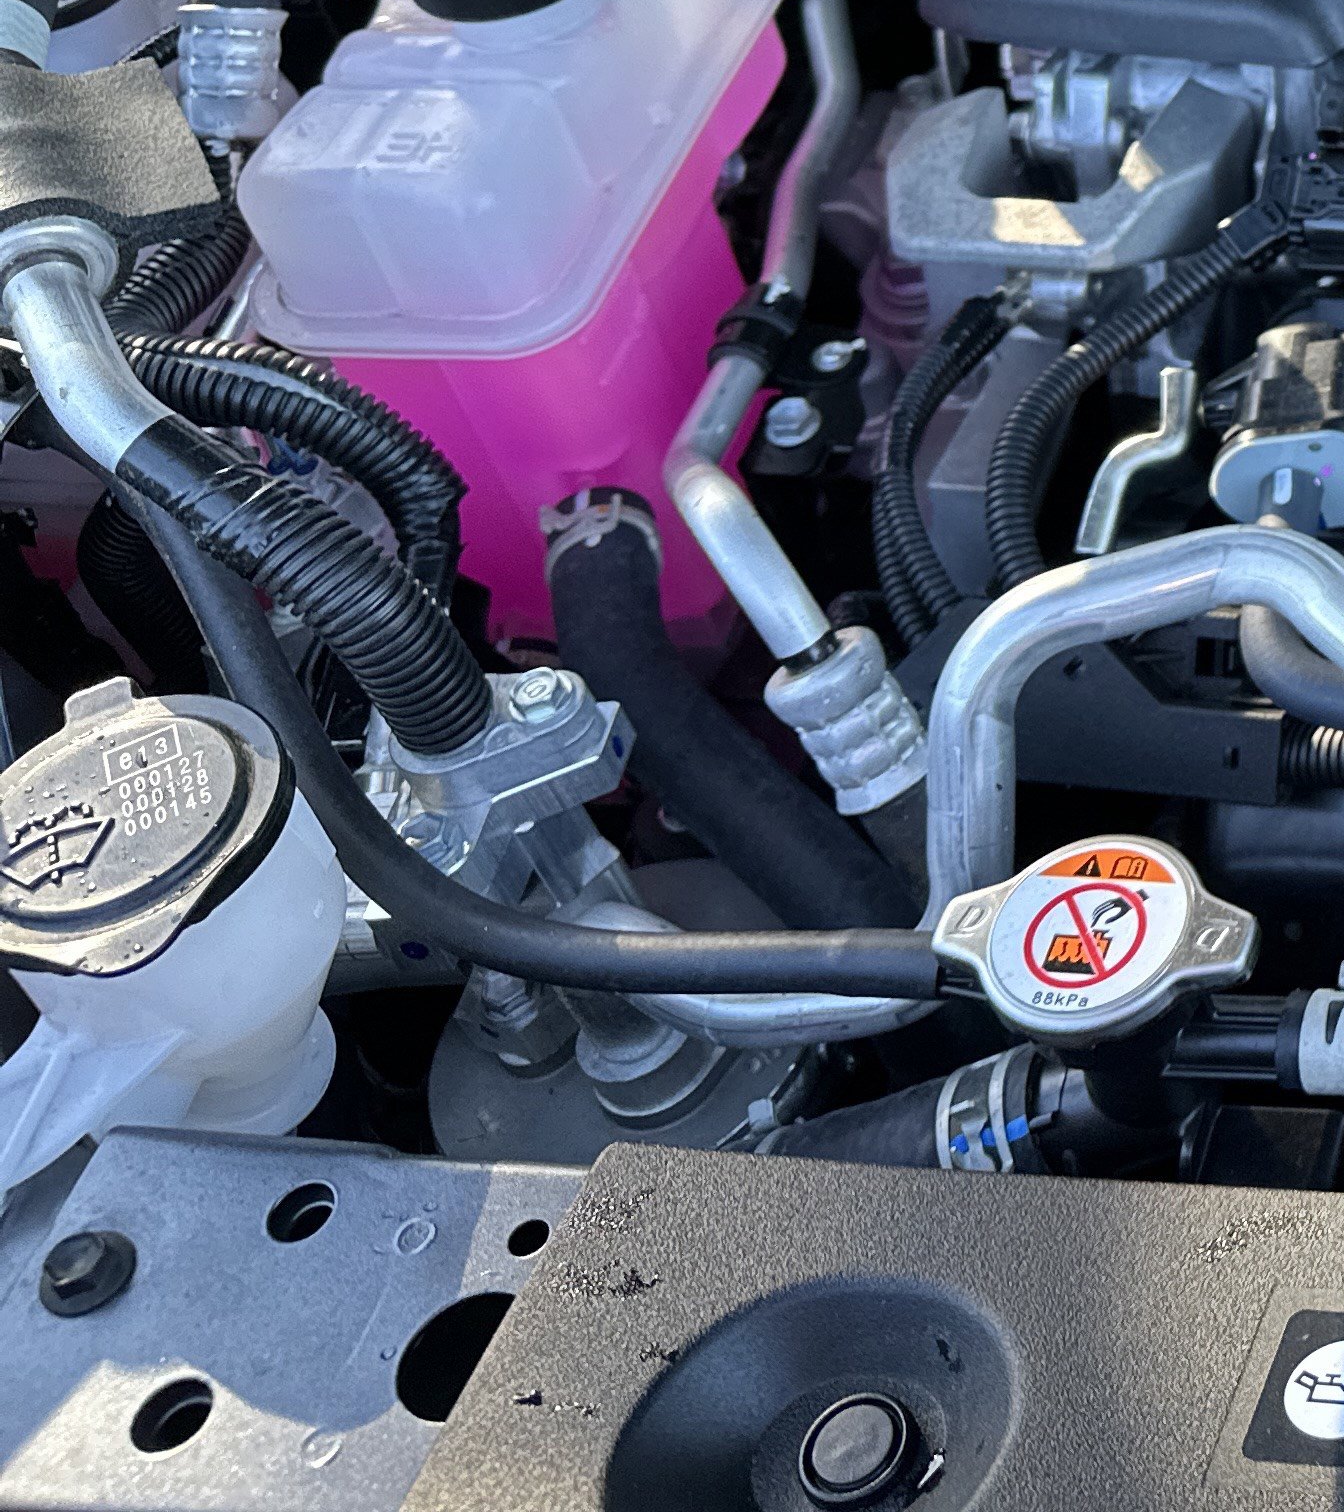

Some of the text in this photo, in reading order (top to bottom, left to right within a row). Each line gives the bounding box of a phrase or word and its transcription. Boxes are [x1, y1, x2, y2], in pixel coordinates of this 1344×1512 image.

[118, 749, 206, 801] 000127
[119, 736, 170, 771] e13
[120, 767, 210, 819] 000128
[123, 786, 213, 837] 000145
[1031, 990, 1091, 1009] 88kPa
